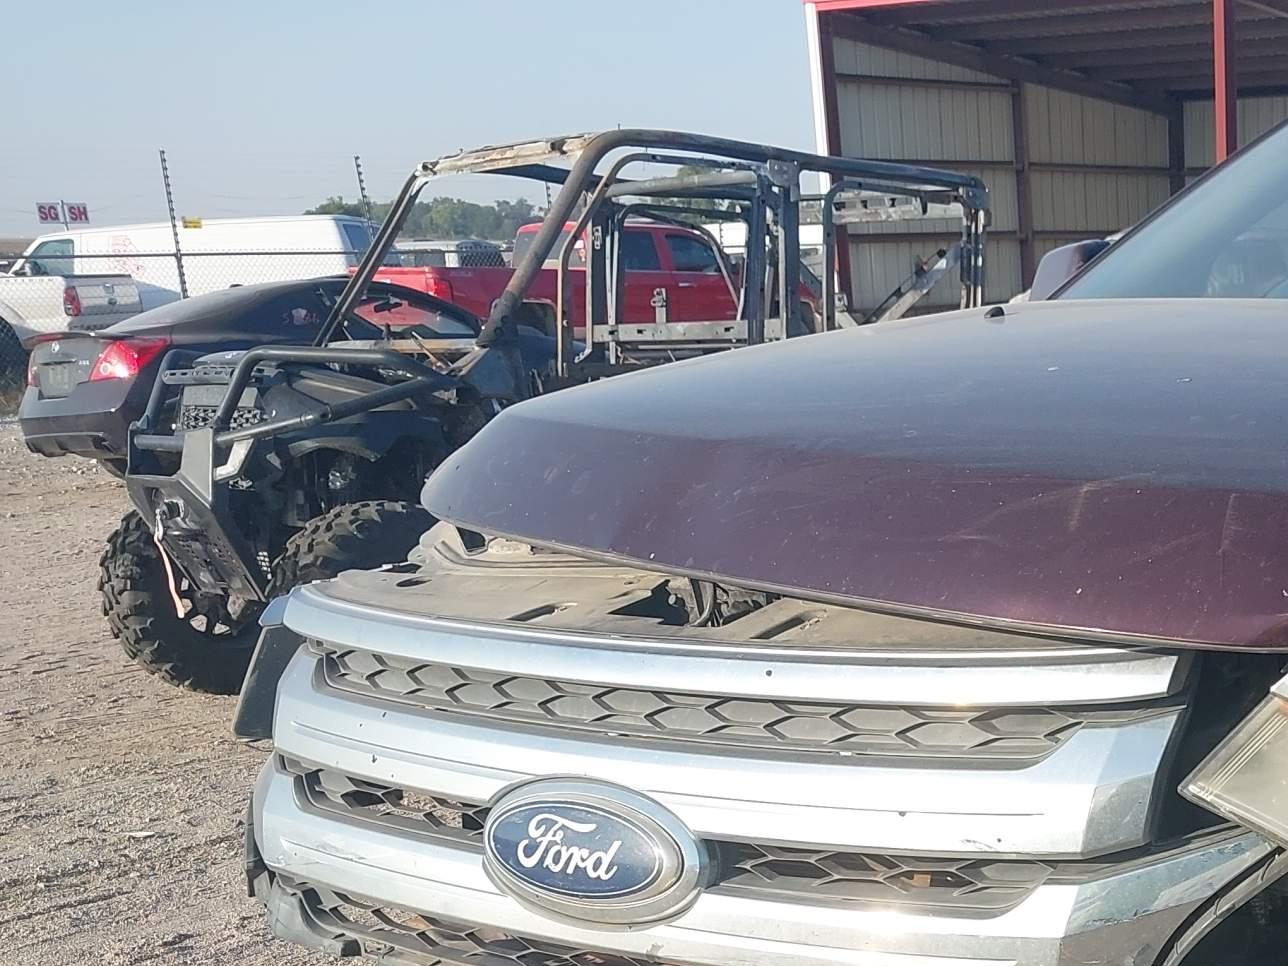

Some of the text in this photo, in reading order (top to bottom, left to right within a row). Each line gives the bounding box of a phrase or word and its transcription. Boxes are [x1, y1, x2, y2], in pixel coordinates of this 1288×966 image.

[38, 205, 59, 221] SG
[68, 206, 88, 221] SH
[517, 813, 622, 880] Ford
